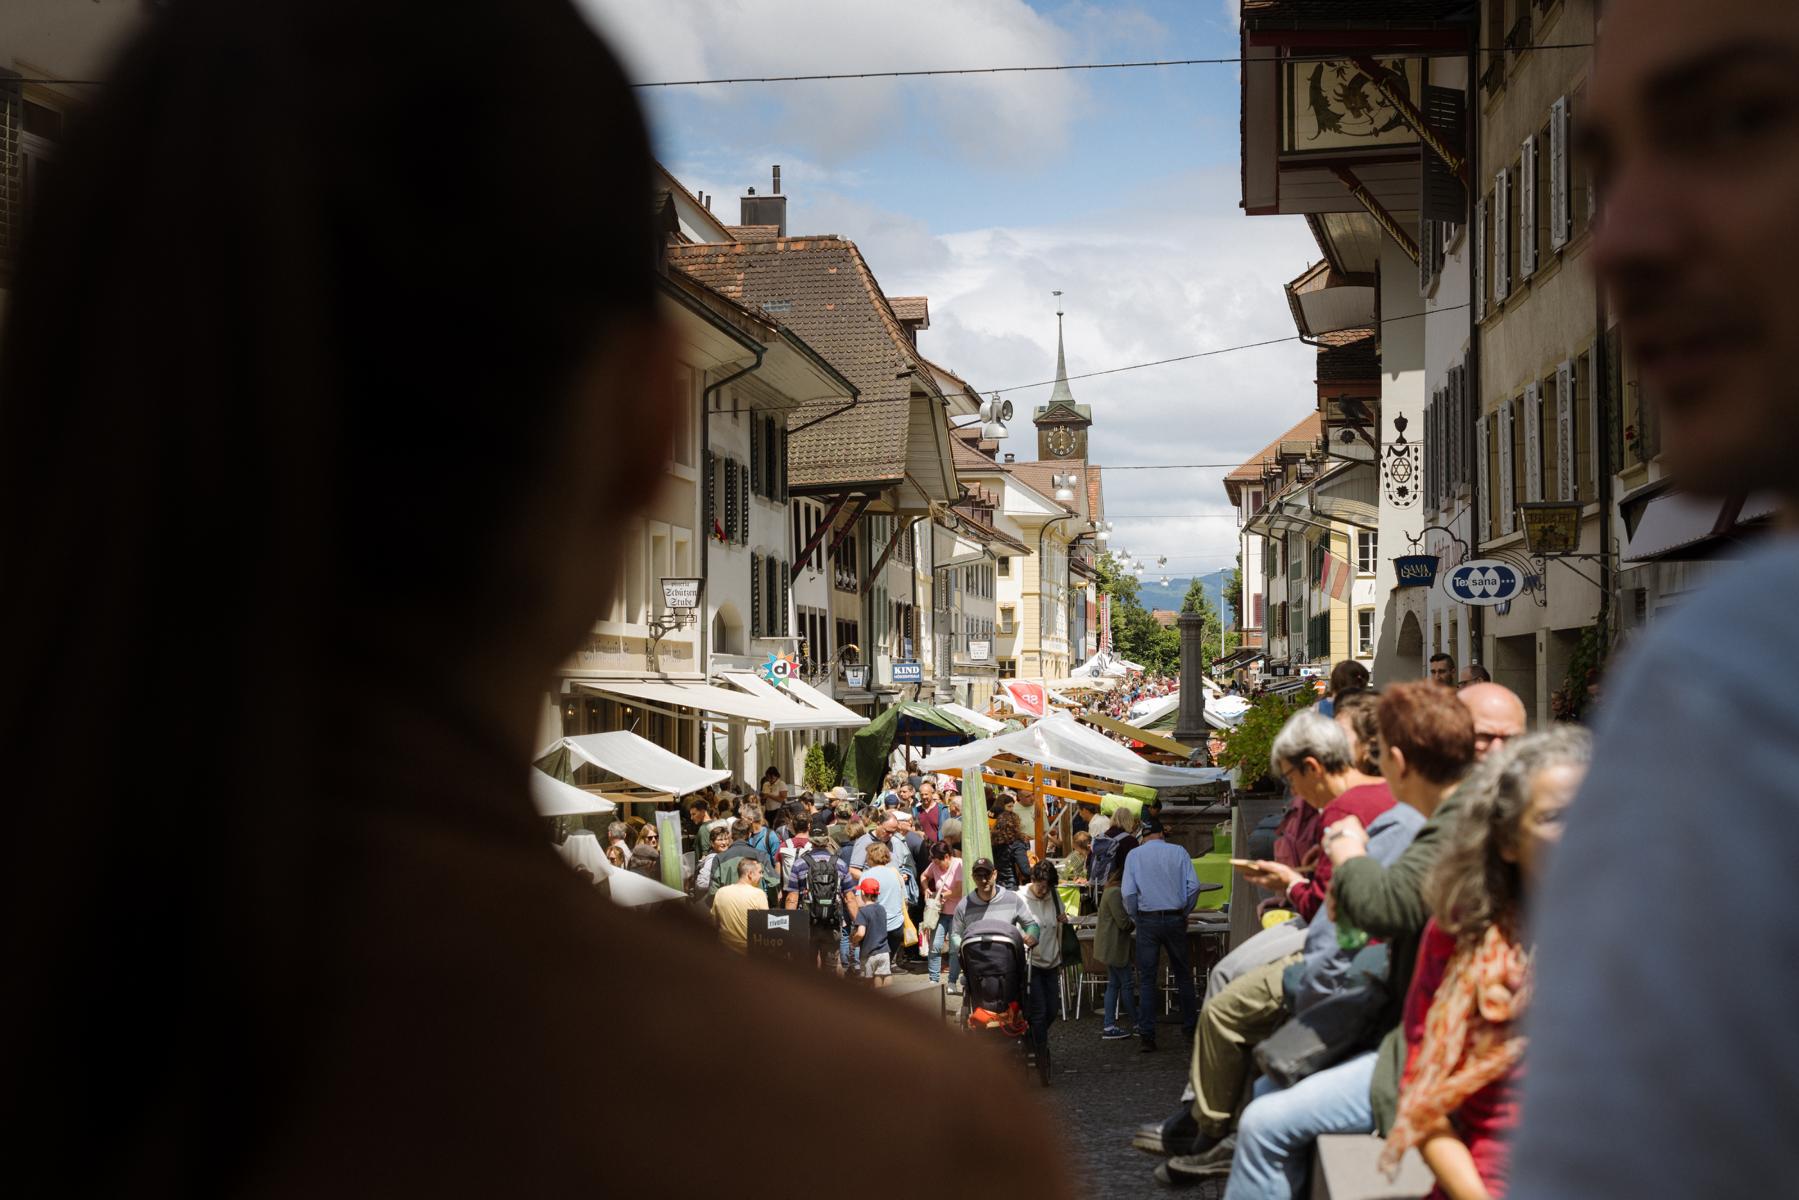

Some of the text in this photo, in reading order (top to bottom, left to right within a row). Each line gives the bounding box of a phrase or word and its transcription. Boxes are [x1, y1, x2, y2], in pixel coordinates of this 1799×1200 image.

[665, 588, 697, 597] Schützen
[671, 597, 693, 606] Stube
[774, 662, 787, 675] d
[894, 666, 920, 674] KIND
[753, 933, 784, 947] Hugo
